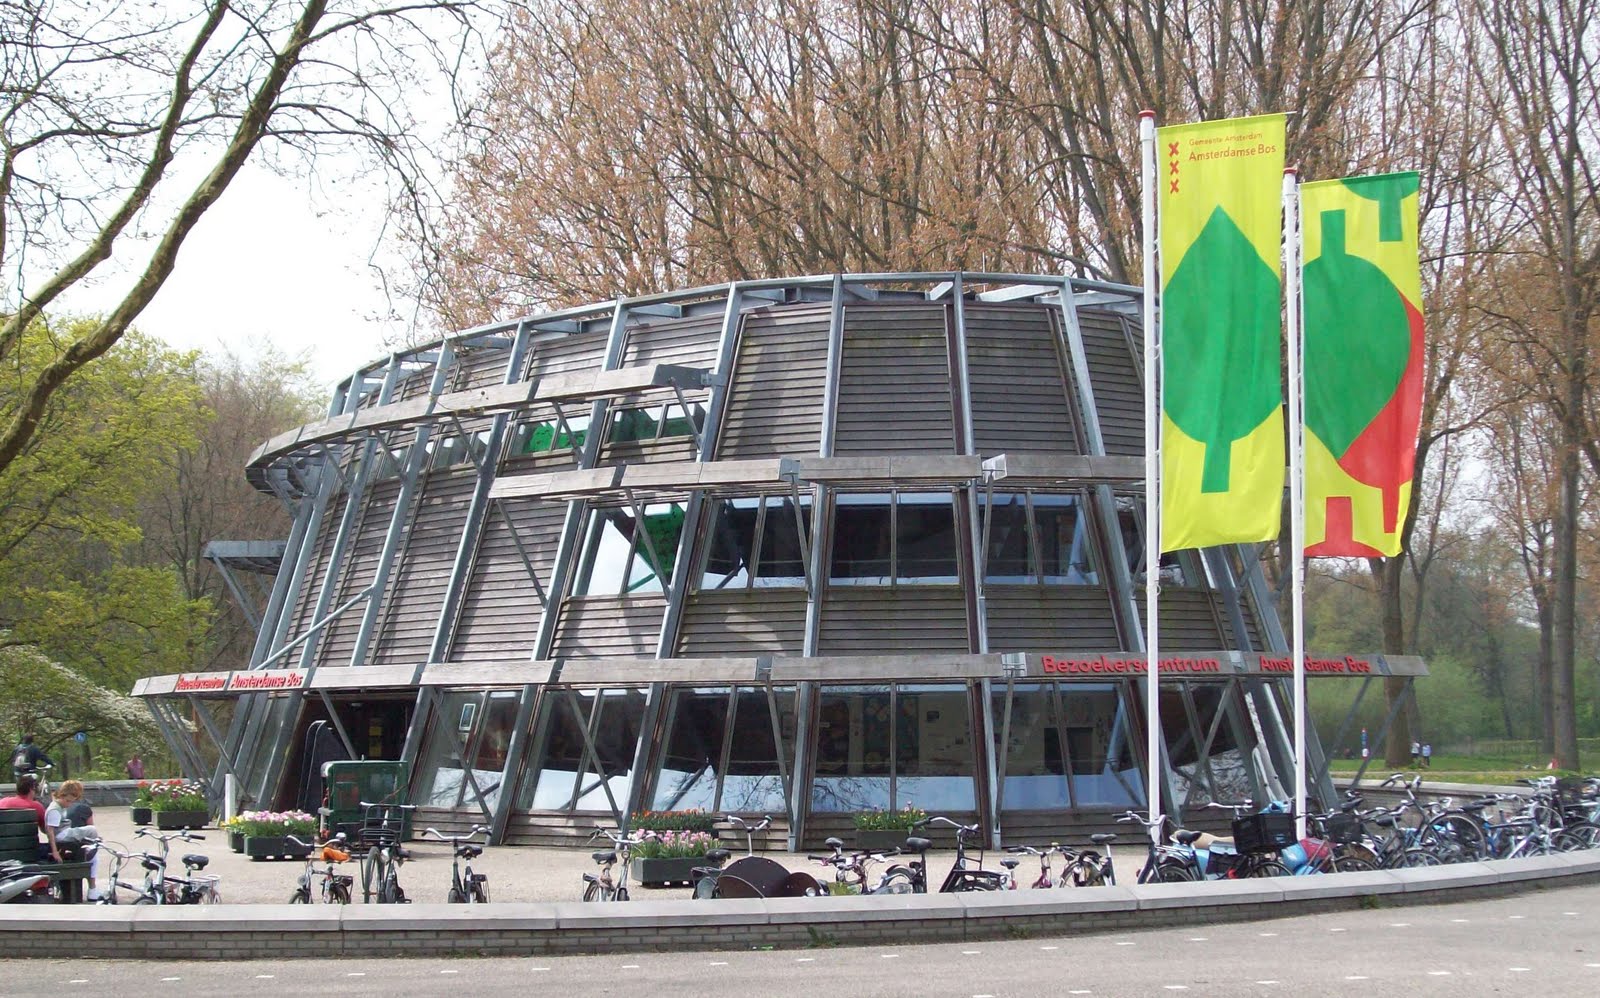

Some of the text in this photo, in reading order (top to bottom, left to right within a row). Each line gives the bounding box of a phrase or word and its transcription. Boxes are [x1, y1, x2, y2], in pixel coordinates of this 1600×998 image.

[1189, 132, 1263, 146] Gemeente Amsterdam
[1189, 143, 1277, 161] Amsterdamse Bos
[1346, 656, 1371, 673] Bos
[231, 671, 286, 688] Amsterdamse
[287, 672, 304, 687] Bos
